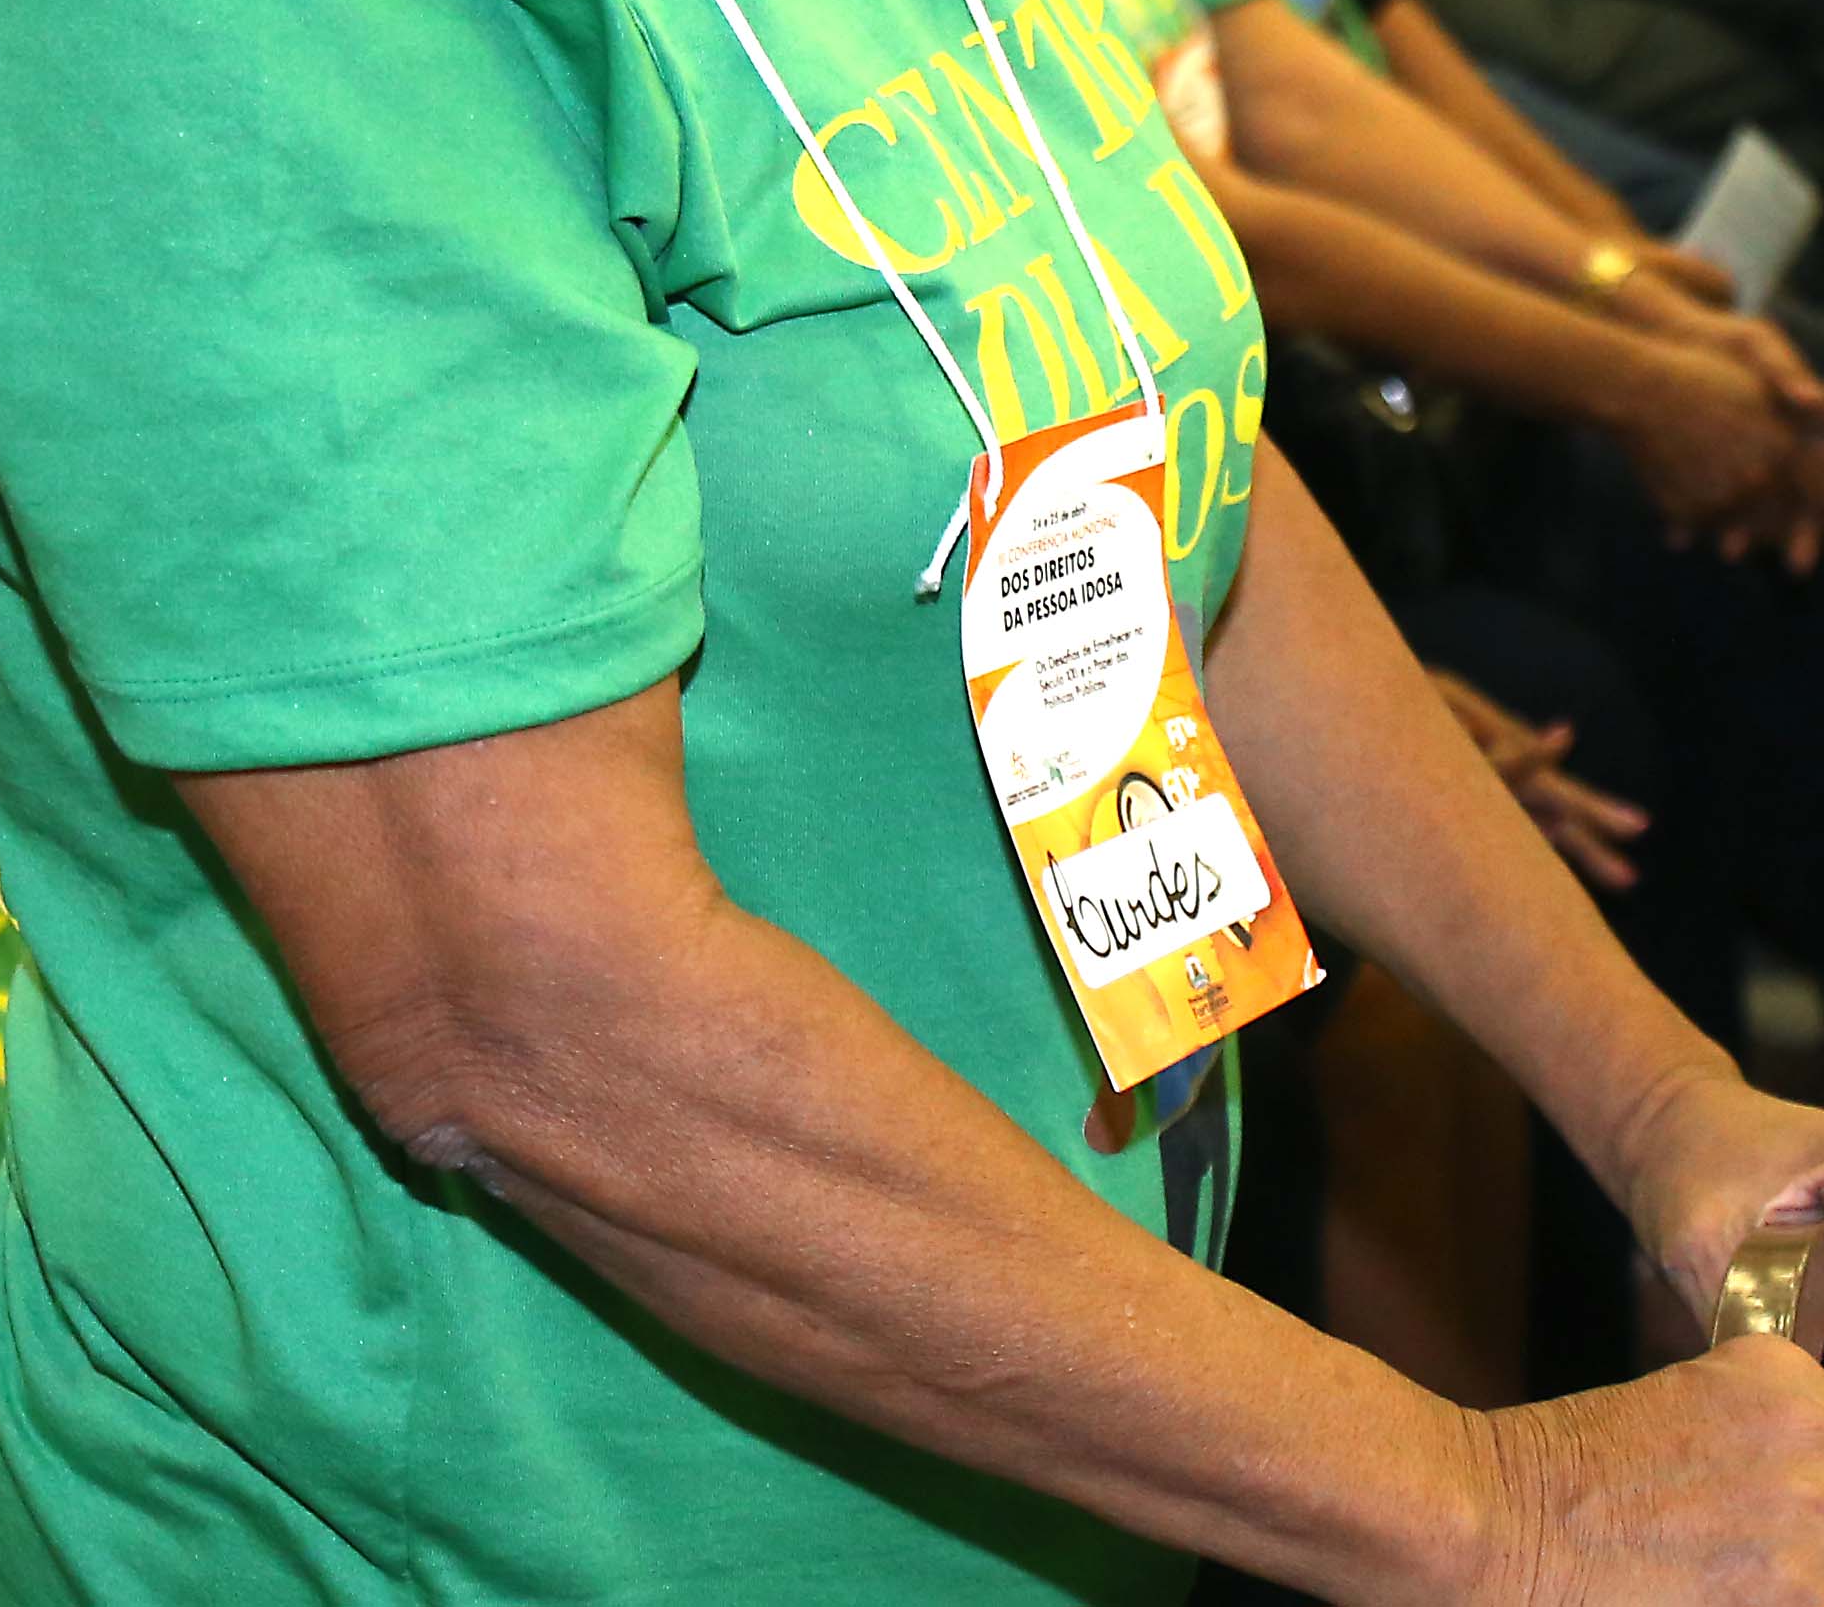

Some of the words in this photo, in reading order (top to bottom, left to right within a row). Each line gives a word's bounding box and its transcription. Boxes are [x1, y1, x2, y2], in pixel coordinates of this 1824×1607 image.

[1001, 568, 1030, 599] DOS
[1034, 545, 1095, 586] DIREITOS
[1003, 606, 1024, 632] DA
[1027, 587, 1079, 624] PESSOA
[1081, 571, 1123, 604] IDOSA
